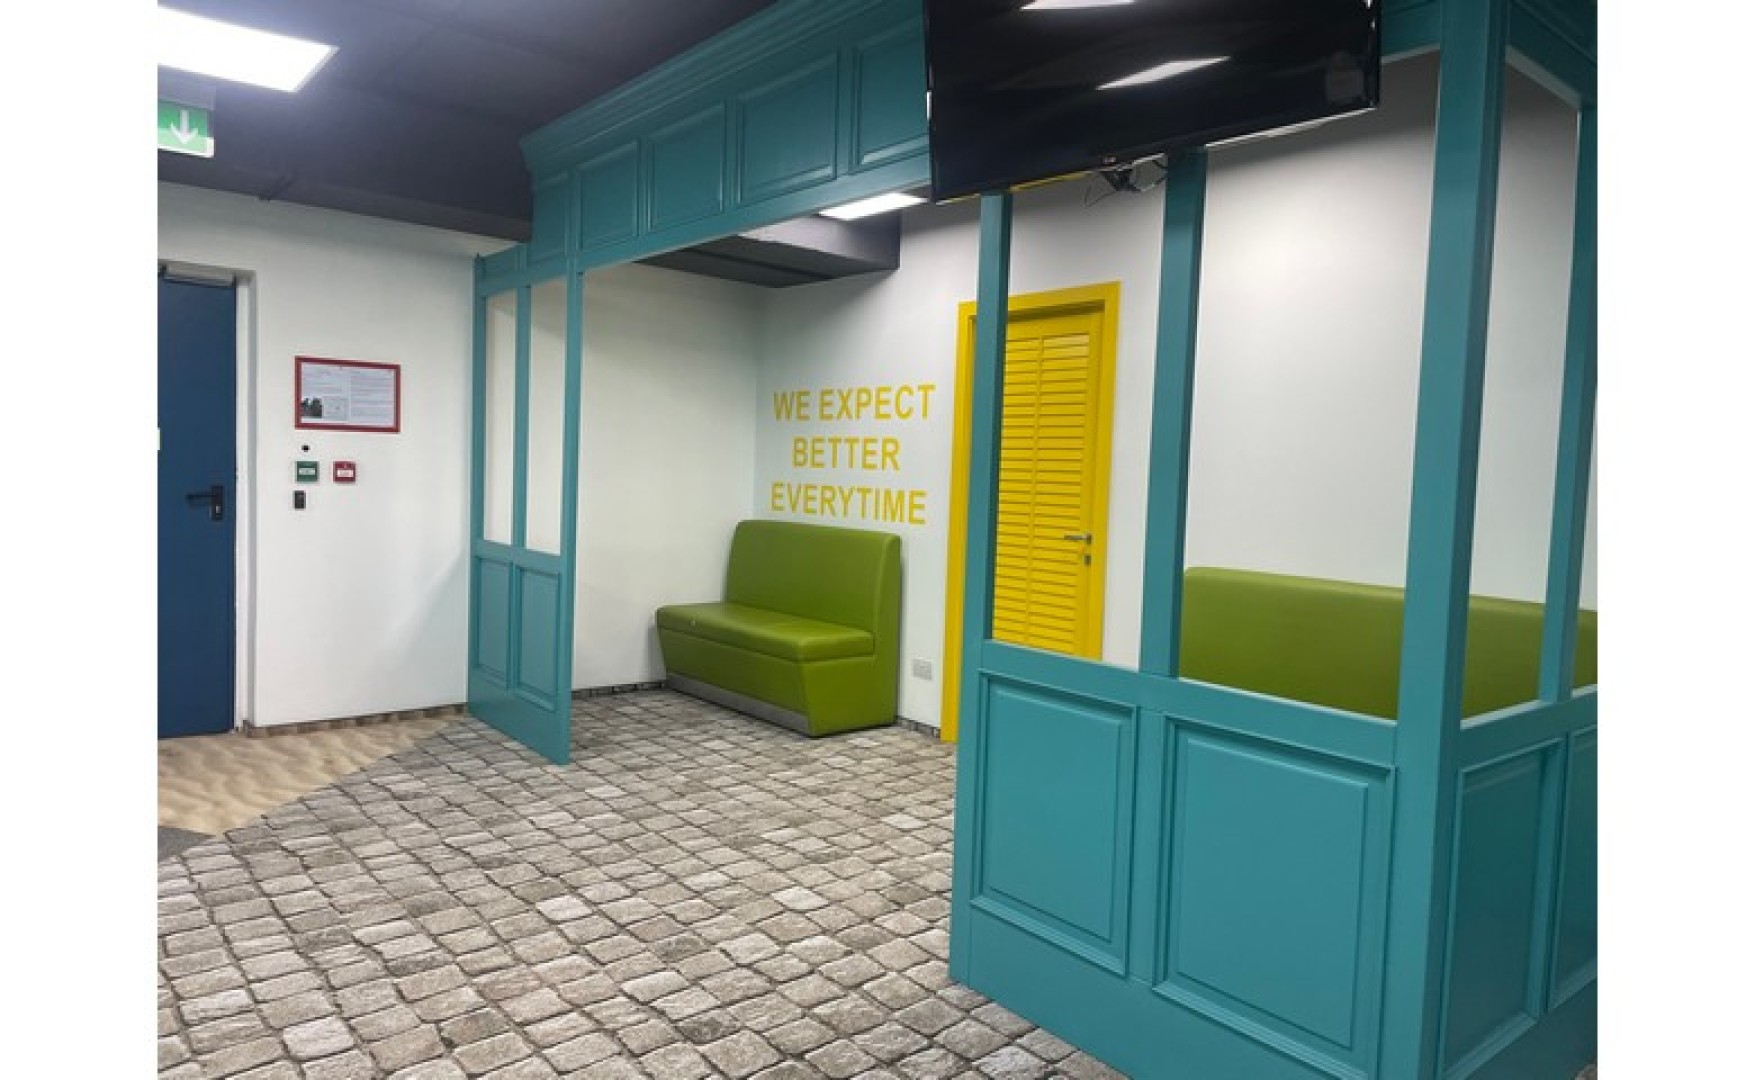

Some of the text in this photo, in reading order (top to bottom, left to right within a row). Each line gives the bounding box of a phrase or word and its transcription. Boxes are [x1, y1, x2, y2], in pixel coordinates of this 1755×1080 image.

[773, 384, 936, 421] WE EXPECT
[792, 436, 901, 470] BETTER
[771, 481, 927, 525] EVERYTIME
